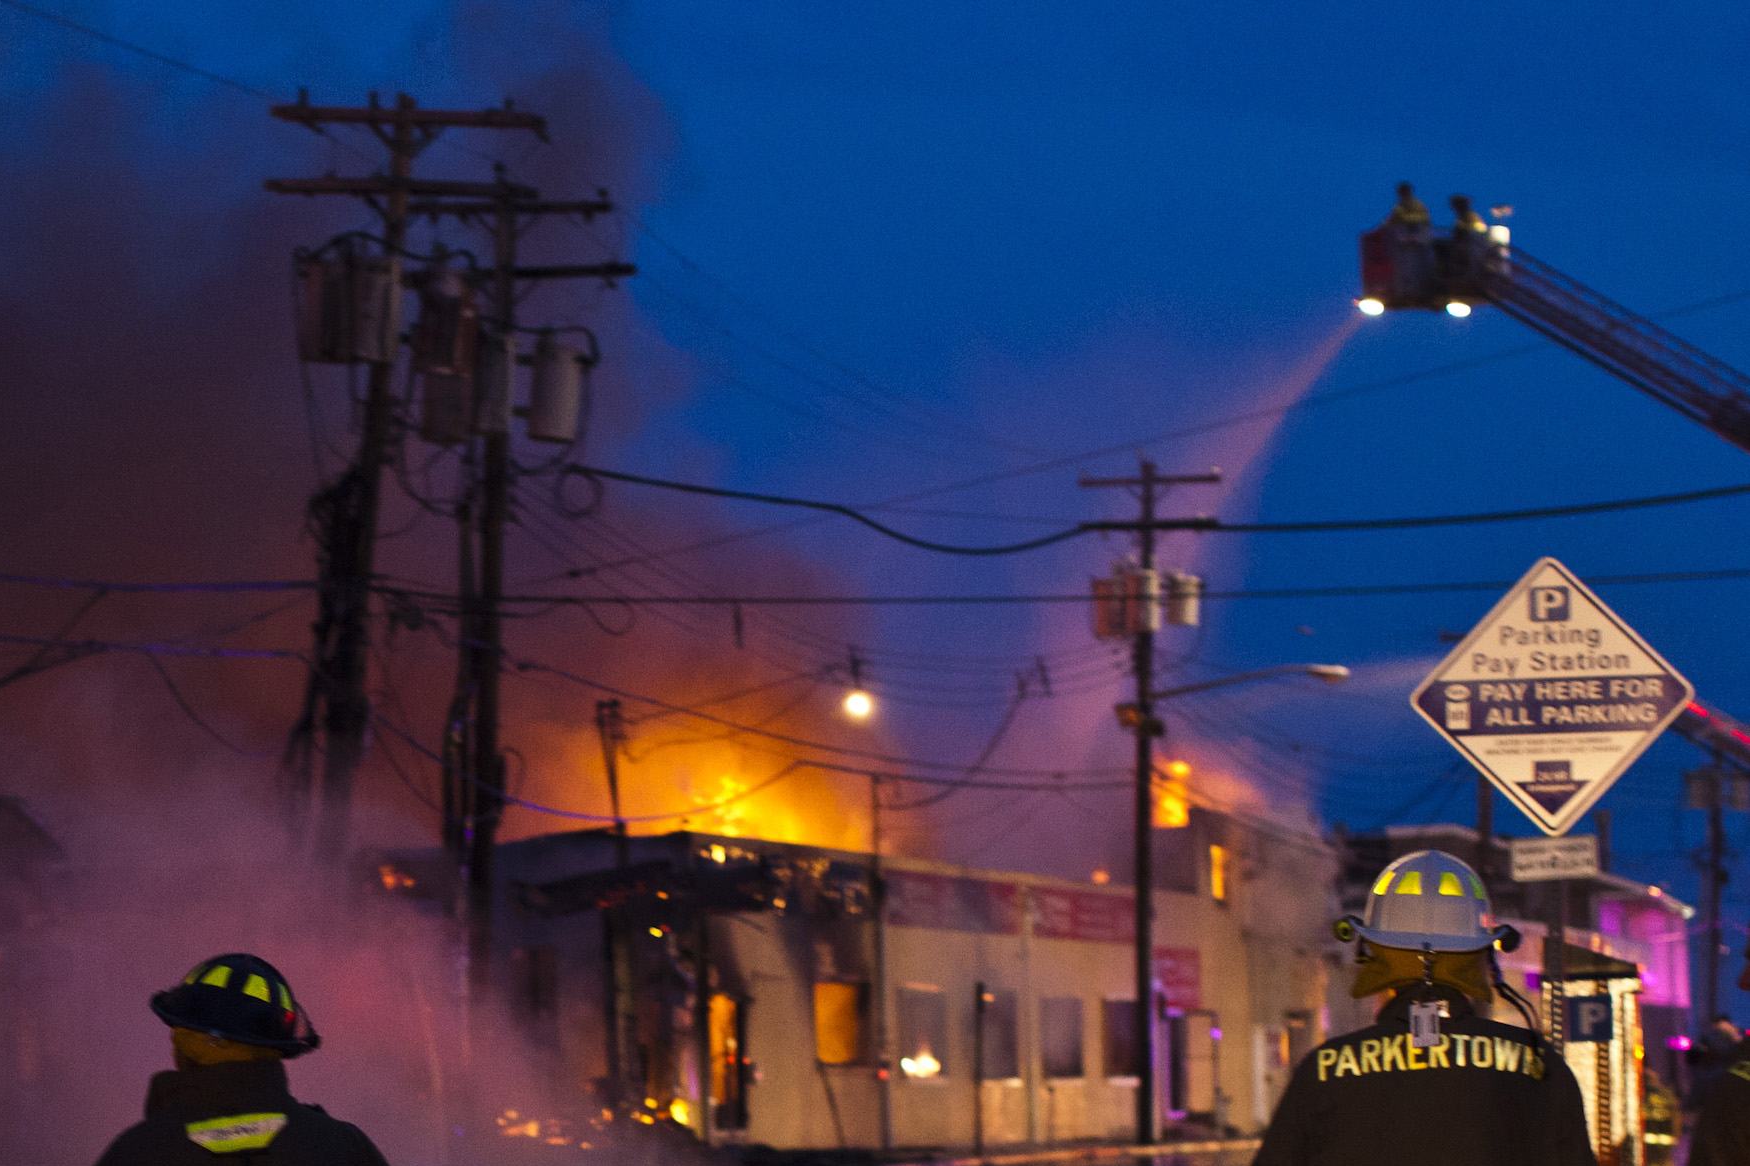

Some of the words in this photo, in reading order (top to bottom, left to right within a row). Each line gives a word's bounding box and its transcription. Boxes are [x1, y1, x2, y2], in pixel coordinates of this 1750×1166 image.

[1535, 589, 1563, 619] P
[1499, 625, 1602, 648] Parking
[1471, 653, 1520, 676] Pay
[1529, 650, 1631, 672] Station
[1478, 683, 1528, 703] PAY
[1534, 680, 1604, 701] HERE
[1609, 678, 1665, 699] FOR
[1484, 706, 1536, 727] ALL
[1541, 703, 1660, 726] PARKING
[1578, 1001, 1605, 1035] P
